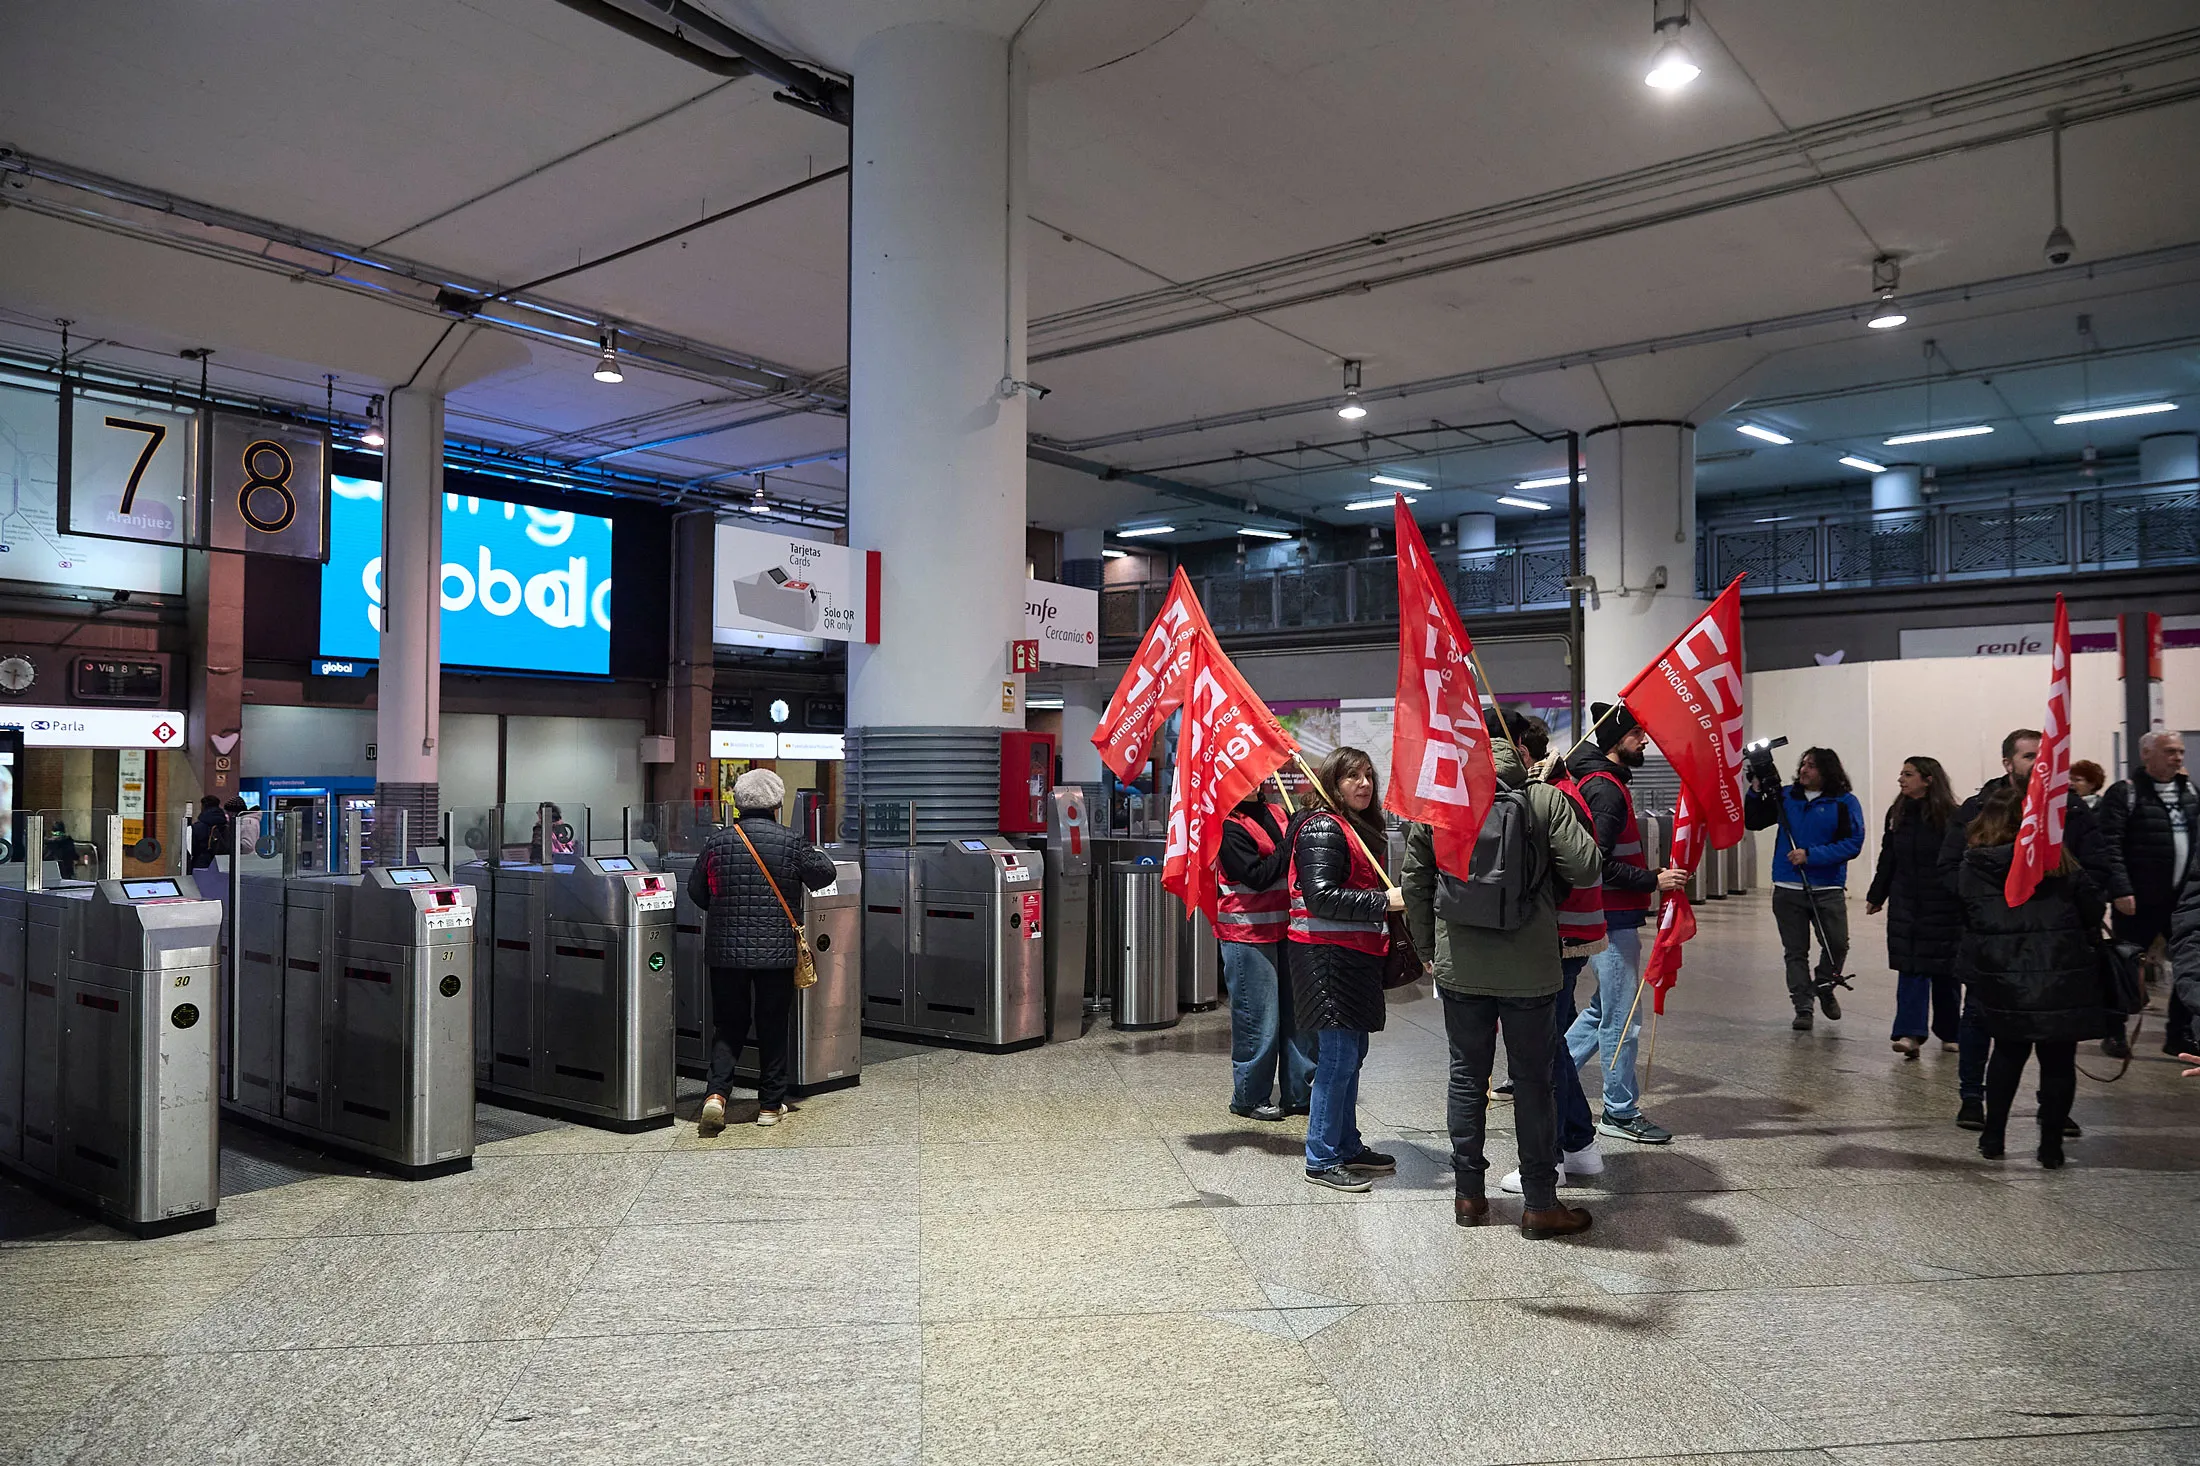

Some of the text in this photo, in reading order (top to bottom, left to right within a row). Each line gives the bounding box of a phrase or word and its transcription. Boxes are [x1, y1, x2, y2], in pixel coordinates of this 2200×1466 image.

[104, 416, 167, 515] 7
[238, 439, 296, 534] 8
[106, 510, 173, 531] Aranjuez
[790, 543, 821, 557] Tarjetas
[789, 554, 811, 567] Cards
[824, 607, 855, 620] Solo QR
[1024, 598, 1057, 624] enfe
[824, 618, 853, 633] QR only
[1045, 625, 1084, 644] Cercanías
[1976, 636, 2042, 655] renfe
[121, 665, 128, 673] 8
[322, 661, 353, 675] global
[1657, 658, 1693, 703] ervicios
[1689, 703, 1702, 714] a
[1698, 714, 1712, 730] la
[53, 720, 85, 731] Parla
[159, 725, 170, 739] 8
[443, 952, 453, 960] 31
[175, 976, 190, 987] 30
